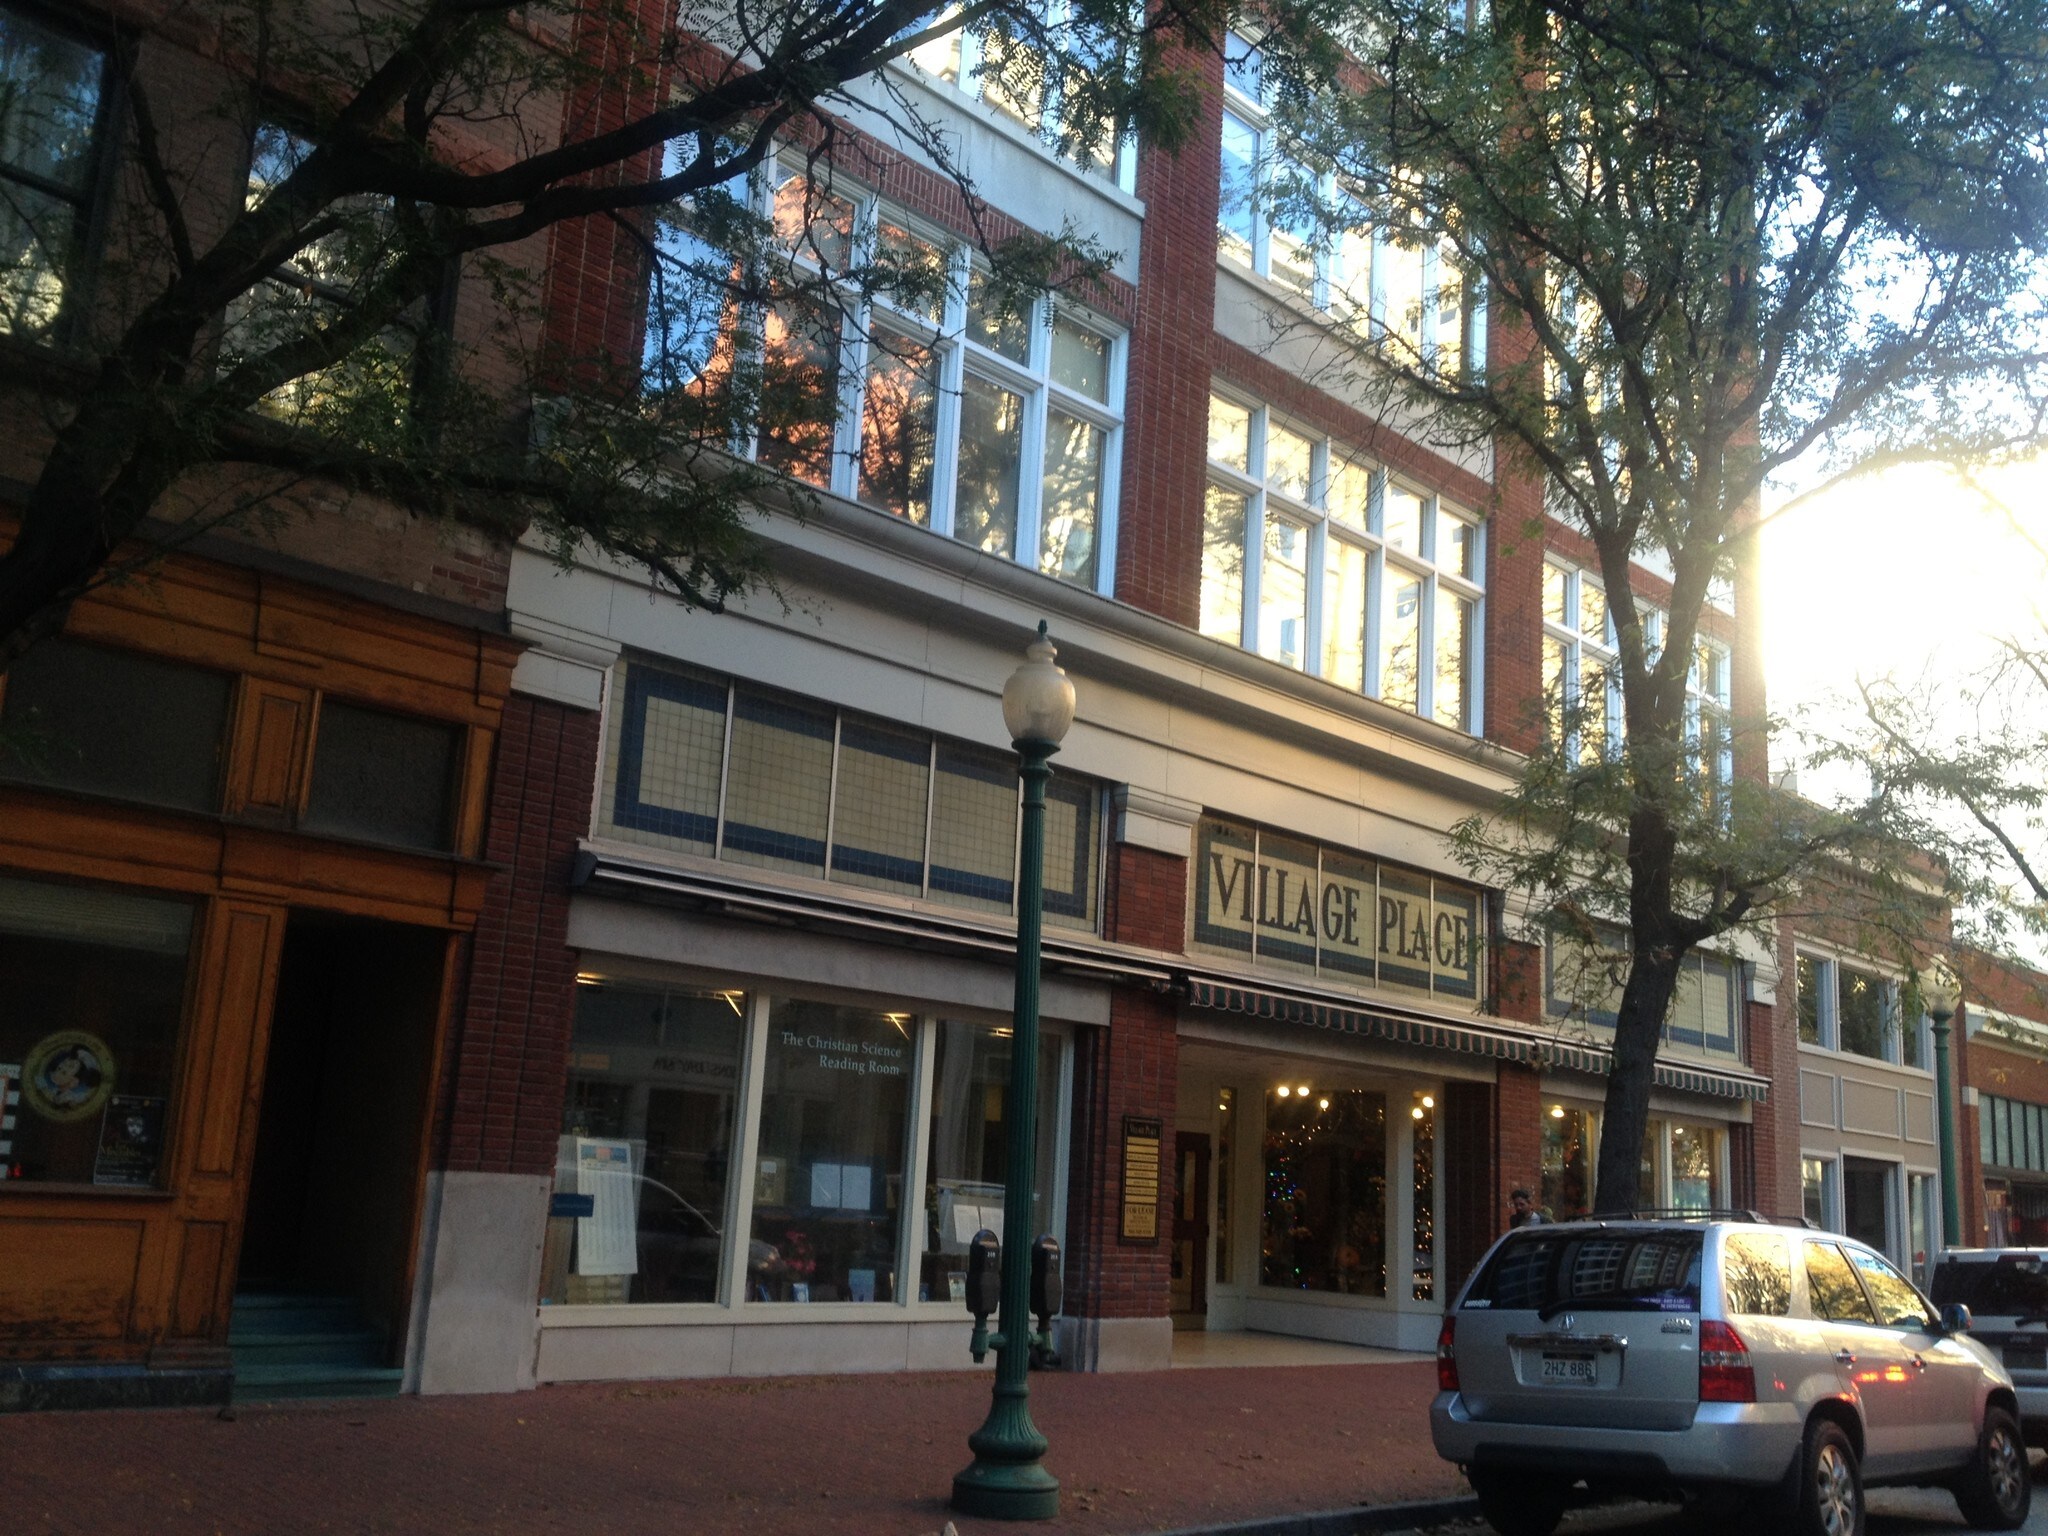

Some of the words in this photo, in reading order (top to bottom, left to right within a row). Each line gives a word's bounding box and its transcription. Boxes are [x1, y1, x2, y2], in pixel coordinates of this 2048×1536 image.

[1210, 853, 1360, 947] VILLAGE
[1379, 895, 1468, 970] PLACE
[782, 1031, 803, 1047] The
[807, 1035, 858, 1053] Christian
[861, 1041, 901, 1058] Science
[819, 1055, 865, 1075] Reading
[869, 1060, 900, 1076] Room
[1544, 1361, 1566, 1377] 2HZ
[1570, 1361, 1592, 1377] 886
